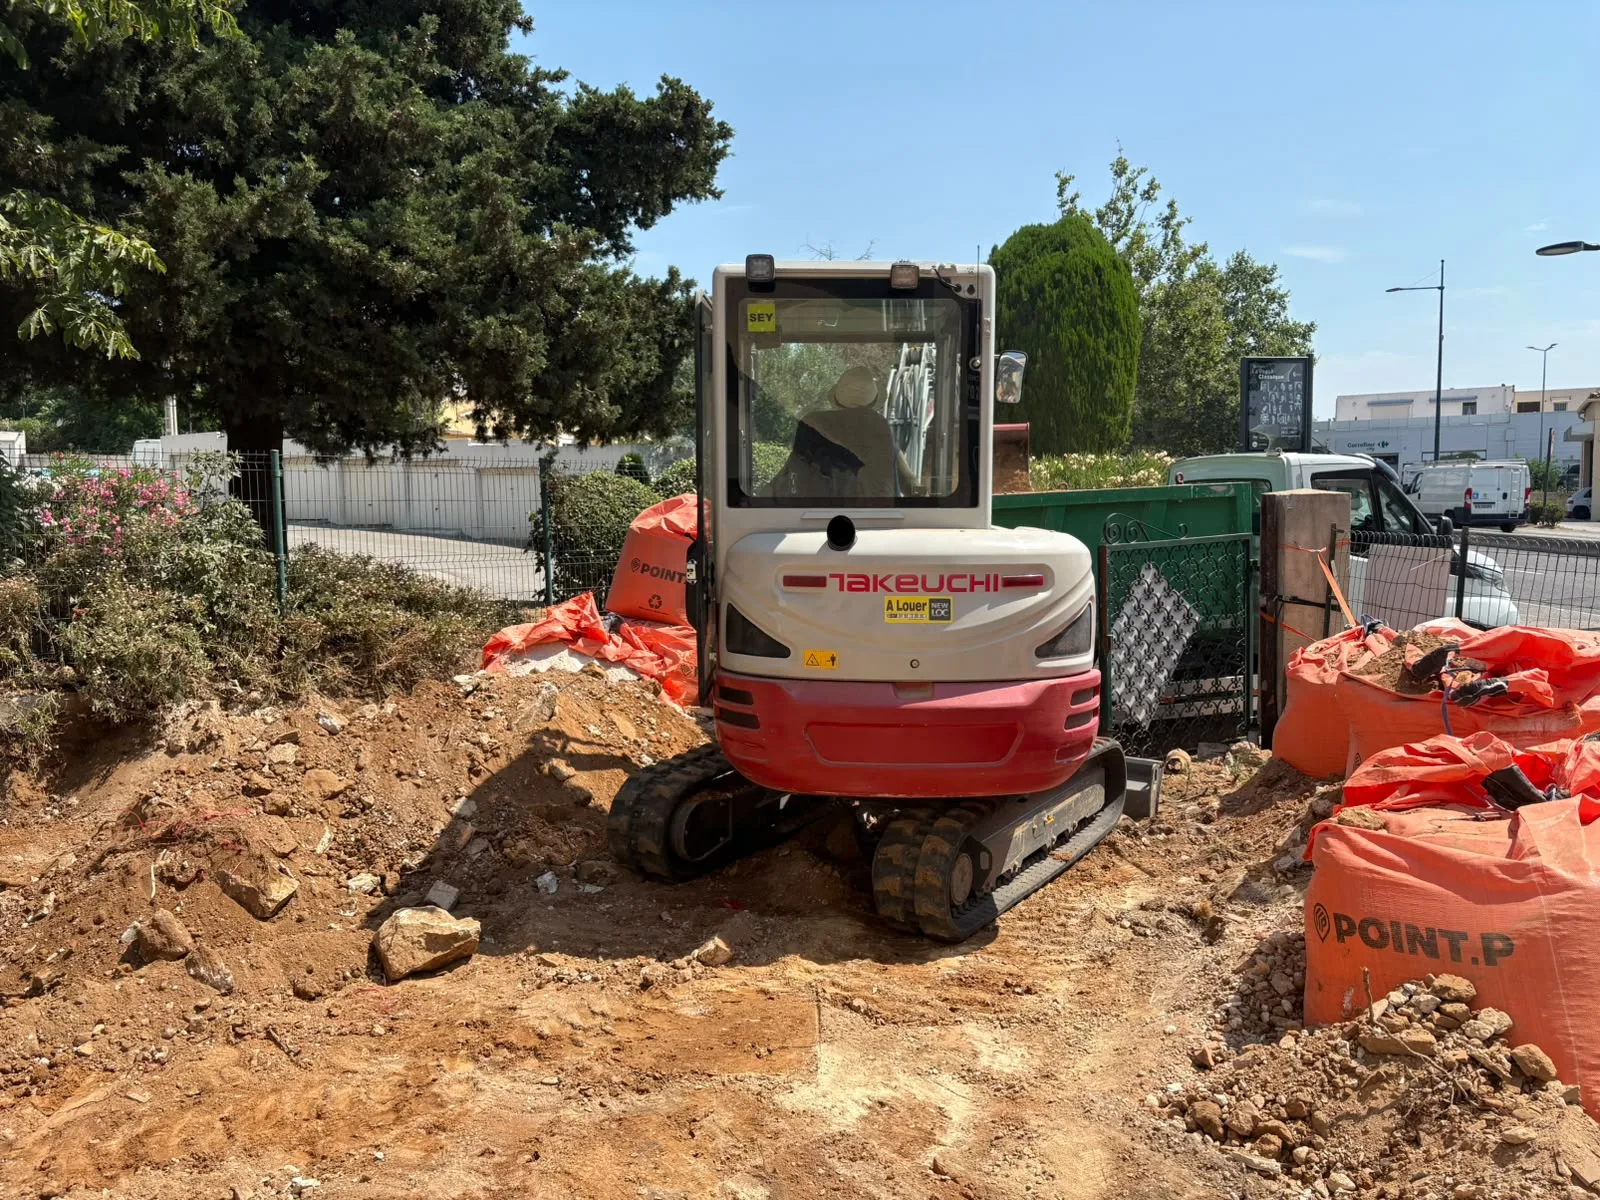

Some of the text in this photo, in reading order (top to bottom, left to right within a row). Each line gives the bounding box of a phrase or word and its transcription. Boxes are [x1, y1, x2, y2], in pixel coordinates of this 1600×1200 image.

[749, 313, 773, 322] SEY
[829, 573, 998, 592] TAKEUCHI
[886, 600, 927, 611] A Louer
[931, 608, 949, 617] LOC
[1333, 912, 1515, 967] POINT.P
